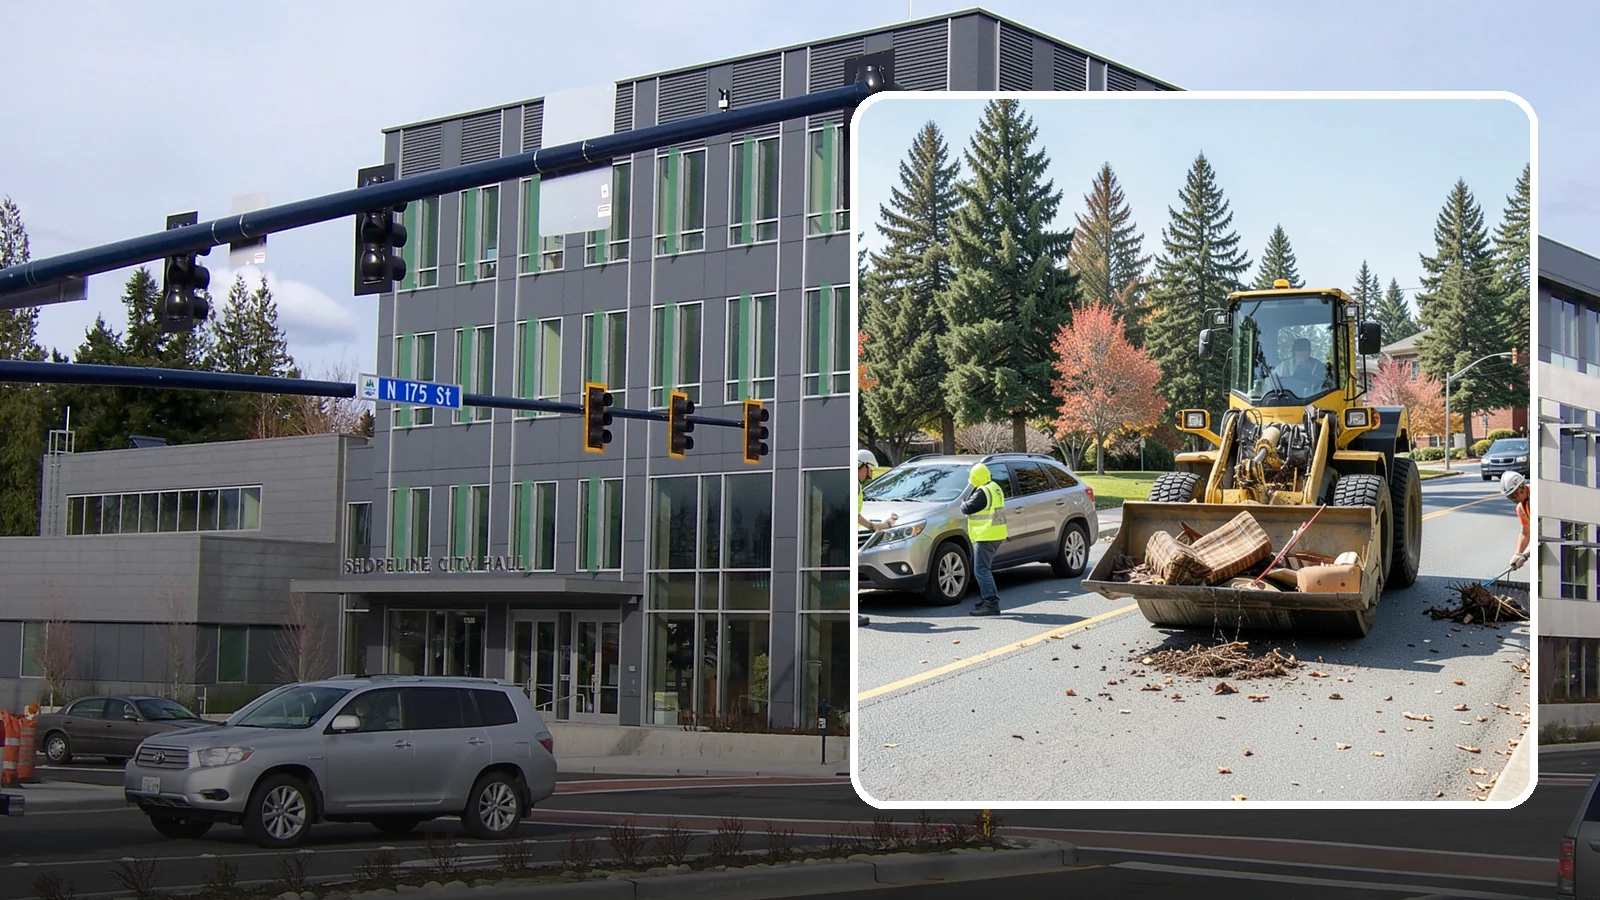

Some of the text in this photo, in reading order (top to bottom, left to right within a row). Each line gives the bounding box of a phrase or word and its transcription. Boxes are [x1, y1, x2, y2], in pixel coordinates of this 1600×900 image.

[387, 381, 451, 406] N 175 St
[344, 555, 525, 574] SHORELINE CITY HALL
